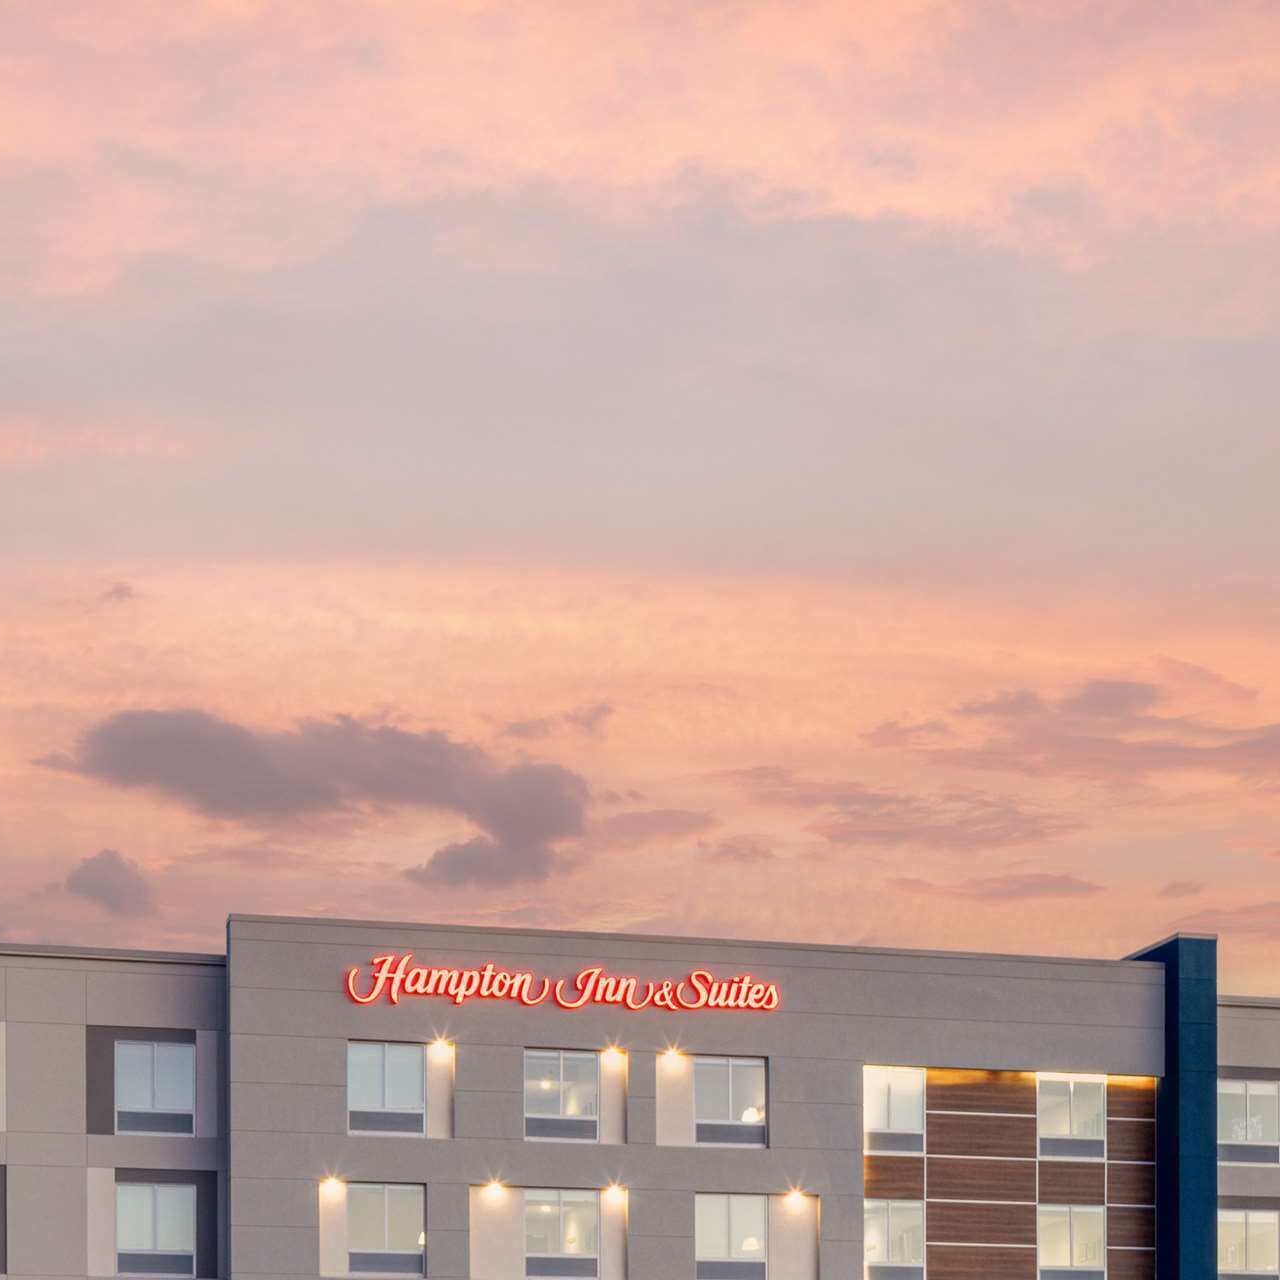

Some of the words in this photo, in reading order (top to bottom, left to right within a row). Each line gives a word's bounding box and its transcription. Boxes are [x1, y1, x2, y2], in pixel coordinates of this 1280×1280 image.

[347, 953, 550, 1005] Hampton
[555, 967, 654, 1010] Inn
[653, 980, 679, 1011] &
[676, 969, 780, 1010] Suites
